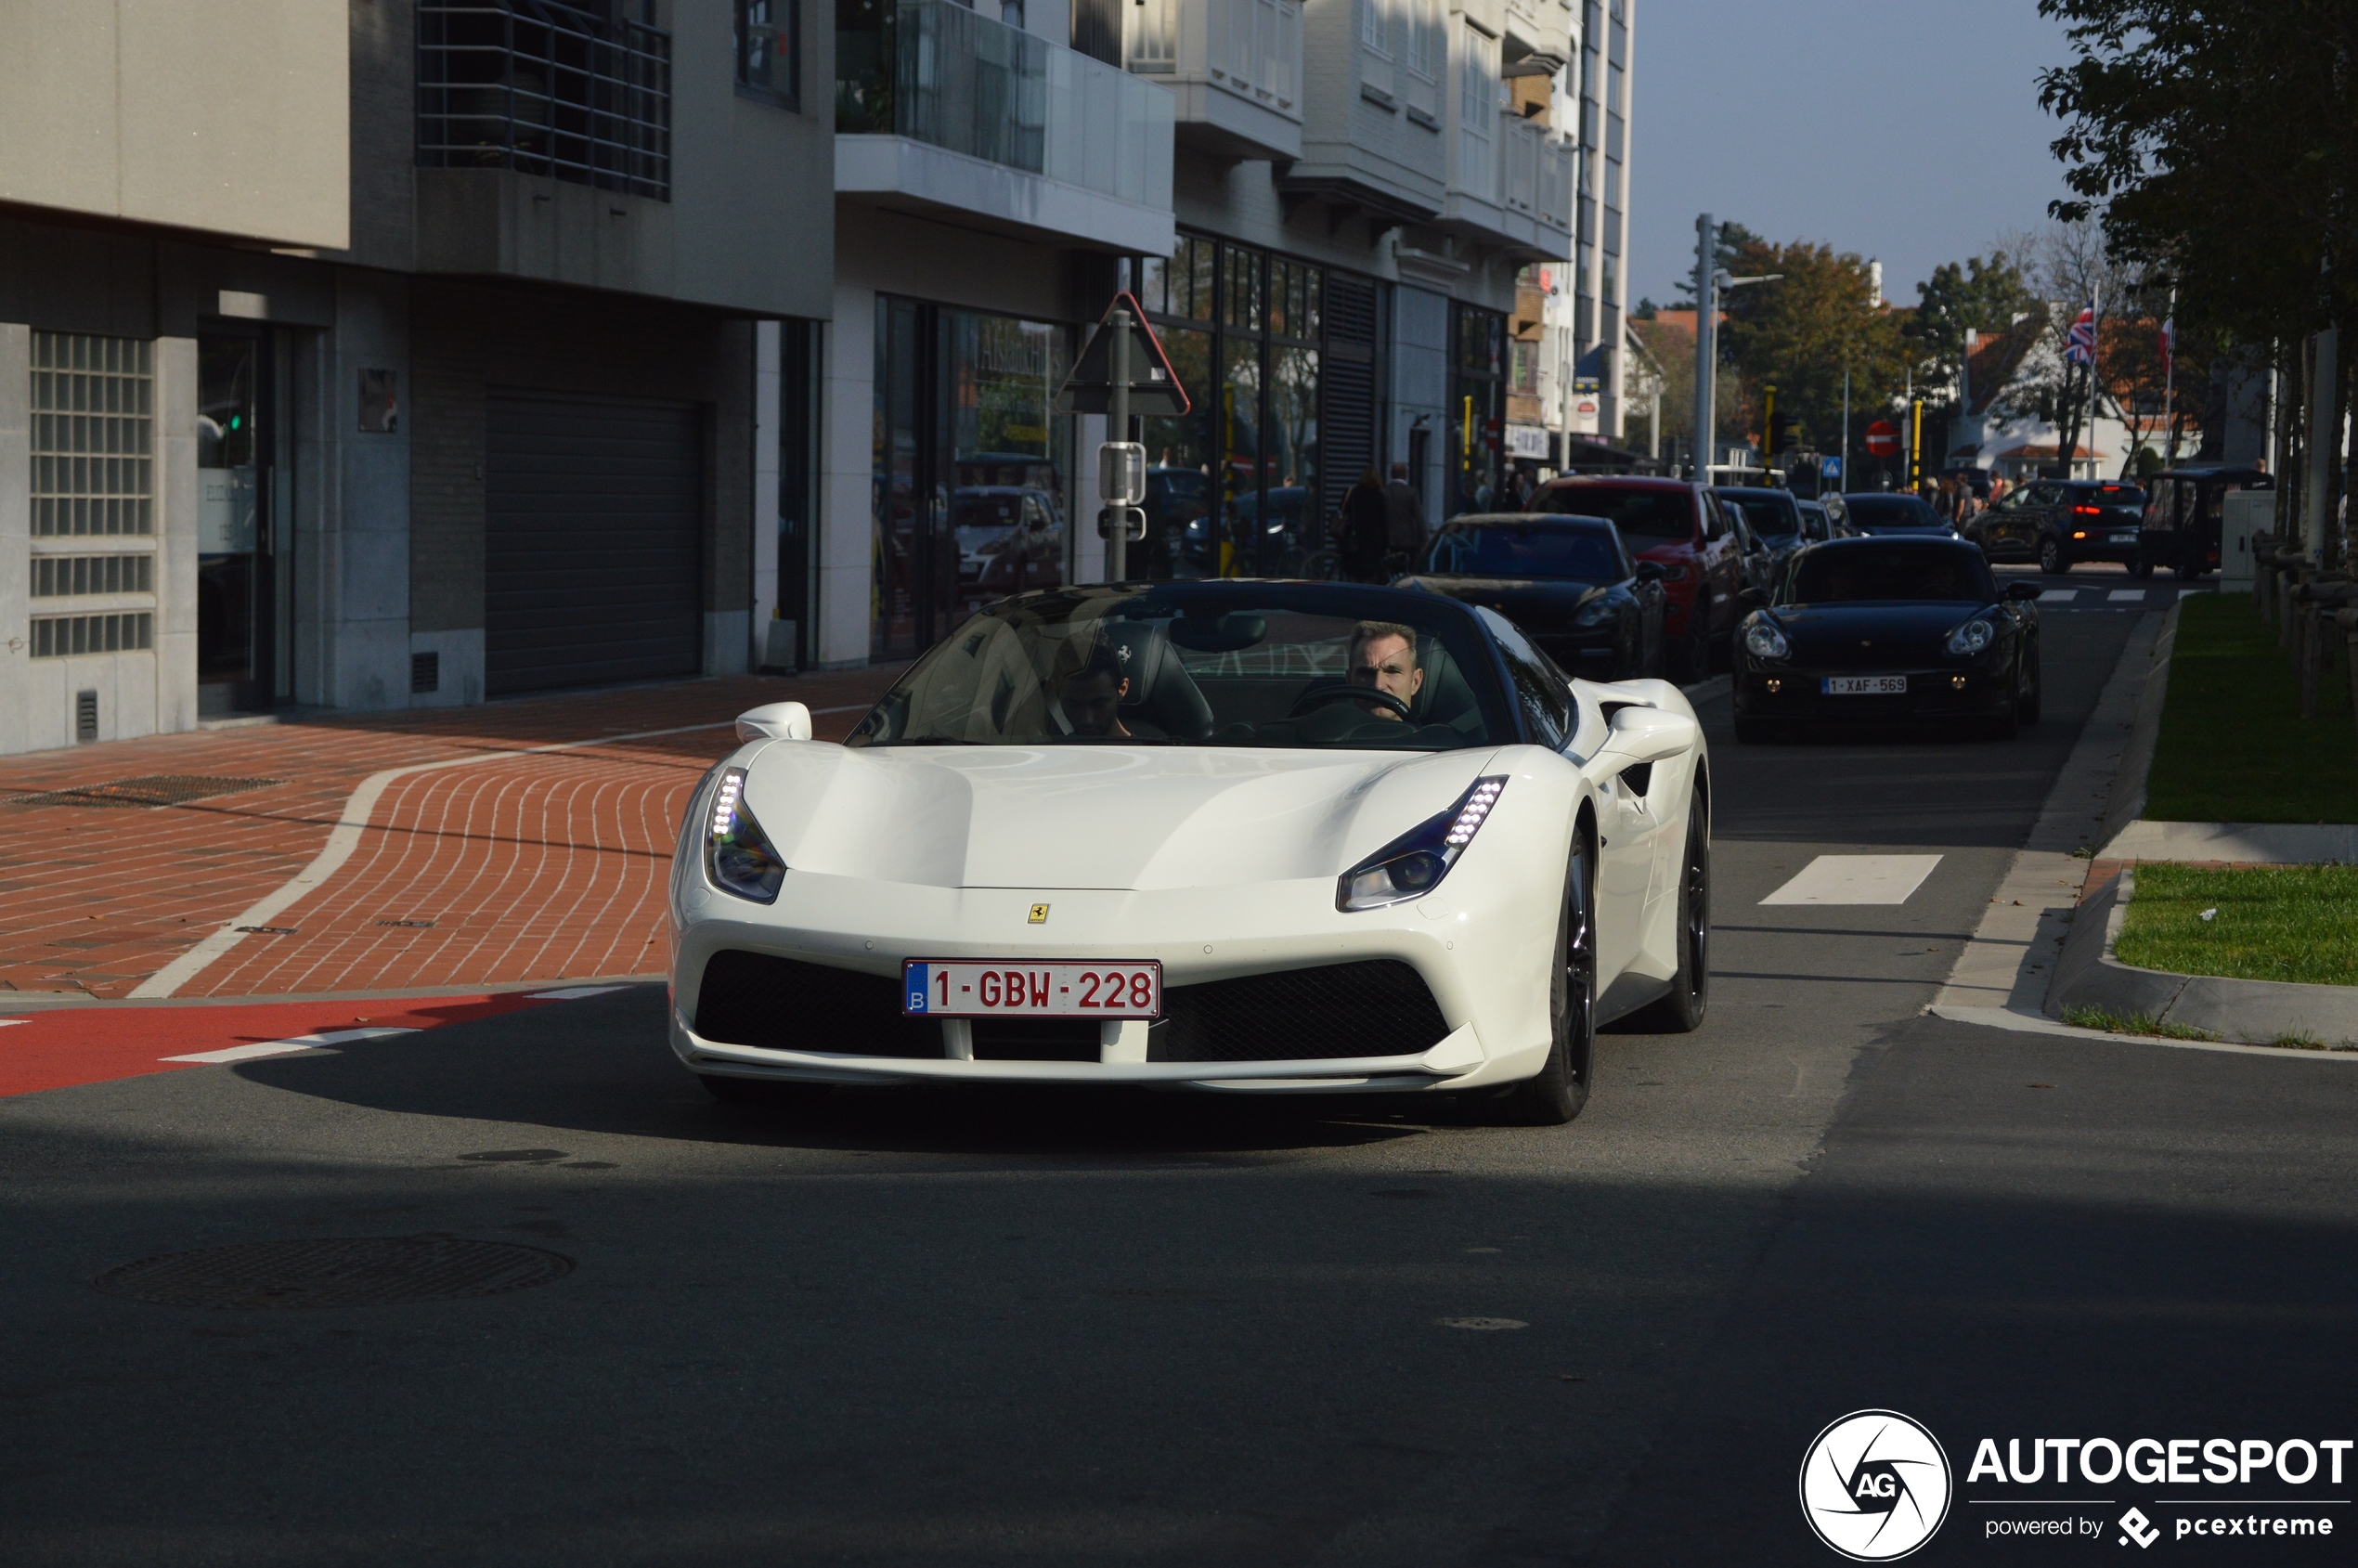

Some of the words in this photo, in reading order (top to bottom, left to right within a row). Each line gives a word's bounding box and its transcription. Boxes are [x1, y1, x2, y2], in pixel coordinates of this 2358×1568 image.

[1831, 679, 1905, 692] 1-XAF-569
[935, 970, 1152, 1008] 1-GBW-228
[911, 992, 925, 1009] B
